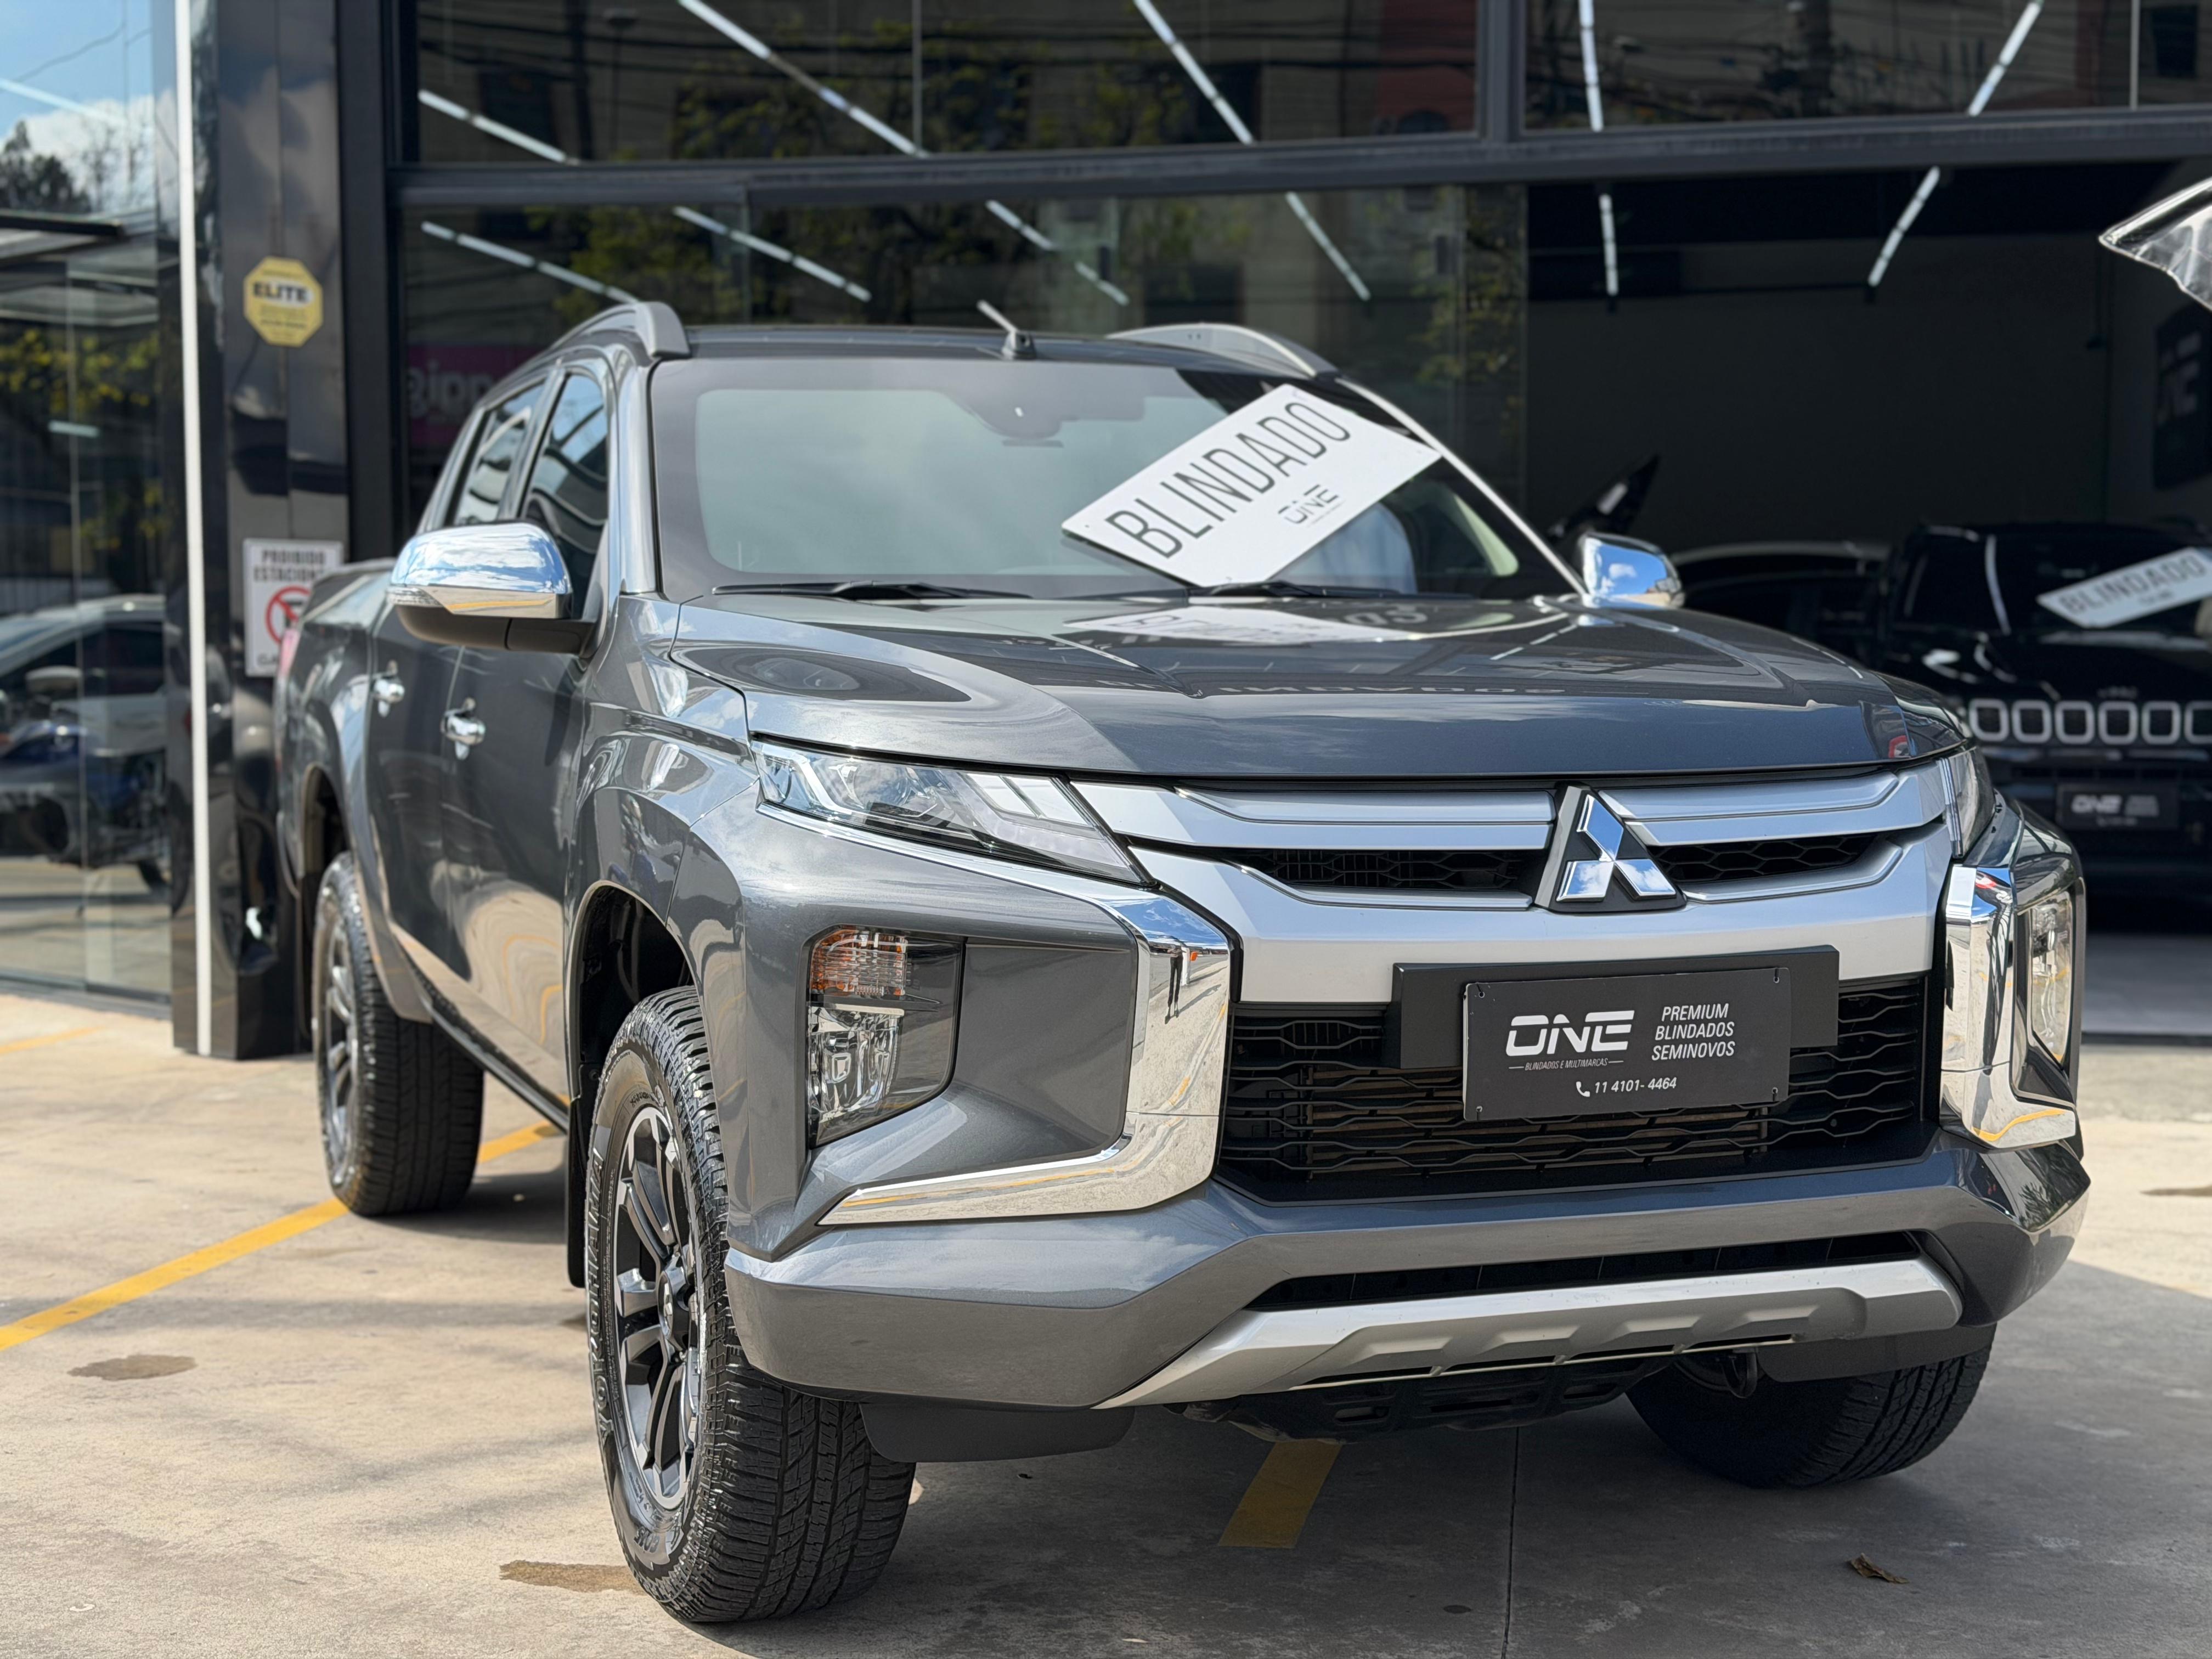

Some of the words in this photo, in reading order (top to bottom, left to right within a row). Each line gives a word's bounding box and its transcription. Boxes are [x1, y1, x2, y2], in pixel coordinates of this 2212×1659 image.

[253, 282, 307, 302] ELITE
[1104, 402, 1351, 559] BLINDADO
[1278, 484, 1339, 524] ONE
[262, 550, 325, 564] PROIBIDO
[2058, 554, 2206, 614] BLINDADO
[1661, 1003, 1729, 1022] PREMIUM
[1505, 1009, 1635, 1057] ONE
[1654, 1021, 1735, 1041] BLINDADOS
[1651, 1041, 1736, 1061] SEMINOVOS
[1525, 1060, 1559, 1071] BLINDADOS
[1560, 1060, 1565, 1069] E
[1565, 1057, 1609, 1069] MULTIMARCAS
[1594, 1081, 1608, 1093] 11
[1647, 1076, 1677, 1090] 4464
[587, 1147, 614, 1443] YOKOHAMA
